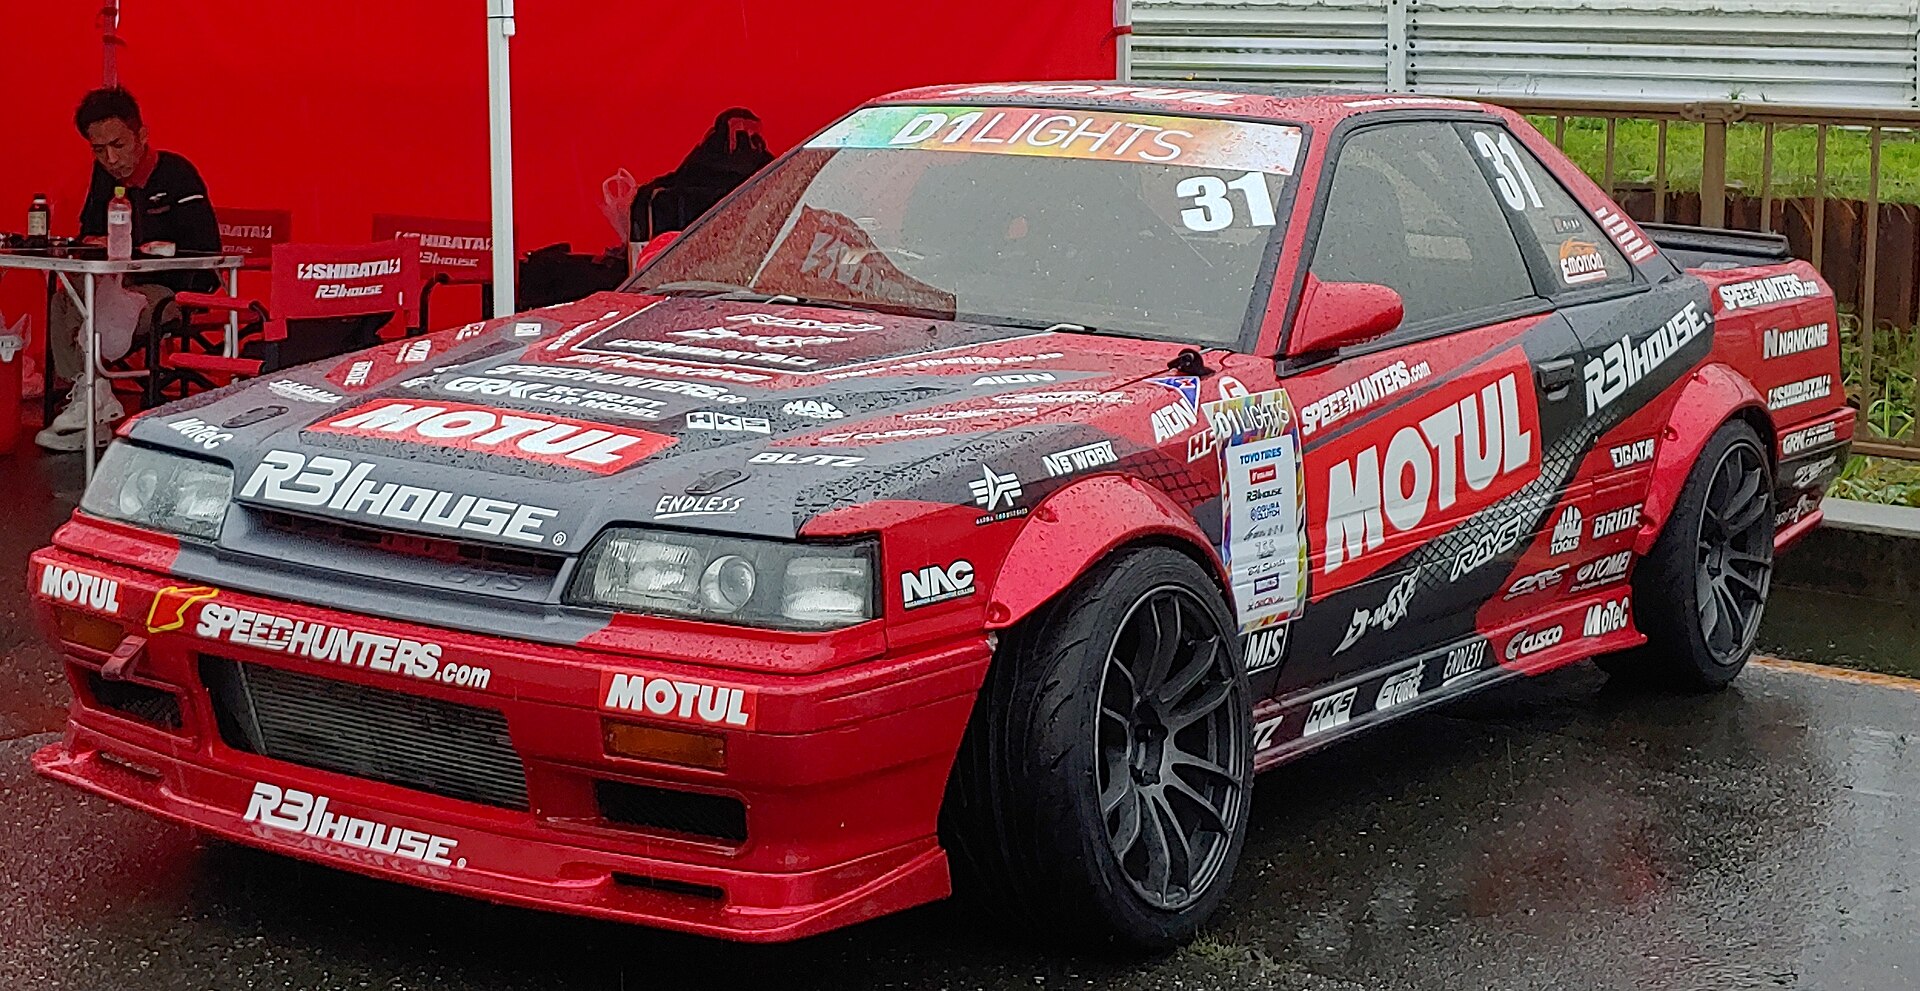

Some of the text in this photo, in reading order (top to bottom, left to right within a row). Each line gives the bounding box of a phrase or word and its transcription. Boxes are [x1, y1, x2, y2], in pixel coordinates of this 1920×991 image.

[1474, 131, 1543, 211] 31
[1176, 172, 1277, 232] 31
[308, 260, 394, 280] SHIBATA
[315, 283, 383, 298] R31HOUSE
[972, 372, 1056, 386] AION
[1583, 300, 1706, 417] R31HOUSE
[578, 399, 661, 418] MODEL
[579, 389, 668, 408] DRIFT
[329, 404, 641, 463] MOTUL
[687, 413, 769, 431] HKS
[749, 452, 867, 467] BLITZ
[1070, 445, 1119, 470] WORK
[1325, 372, 1532, 575] MOTUL
[240, 450, 560, 543] R31HOUSE
[654, 495, 745, 514] ENDLESS
[1592, 503, 1643, 539] BRIDE
[1450, 514, 1521, 582] RAYS
[1550, 537, 1580, 555] TOOLS
[41, 565, 118, 613] MOTUL
[902, 561, 974, 602] NAC
[196, 603, 491, 690] SPEEDHUNTERS.com
[1443, 640, 1487, 681] ENDLESS
[605, 673, 749, 726] MOTUL
[1307, 690, 1355, 733] HKS
[243, 782, 459, 868] R31HOUSE
